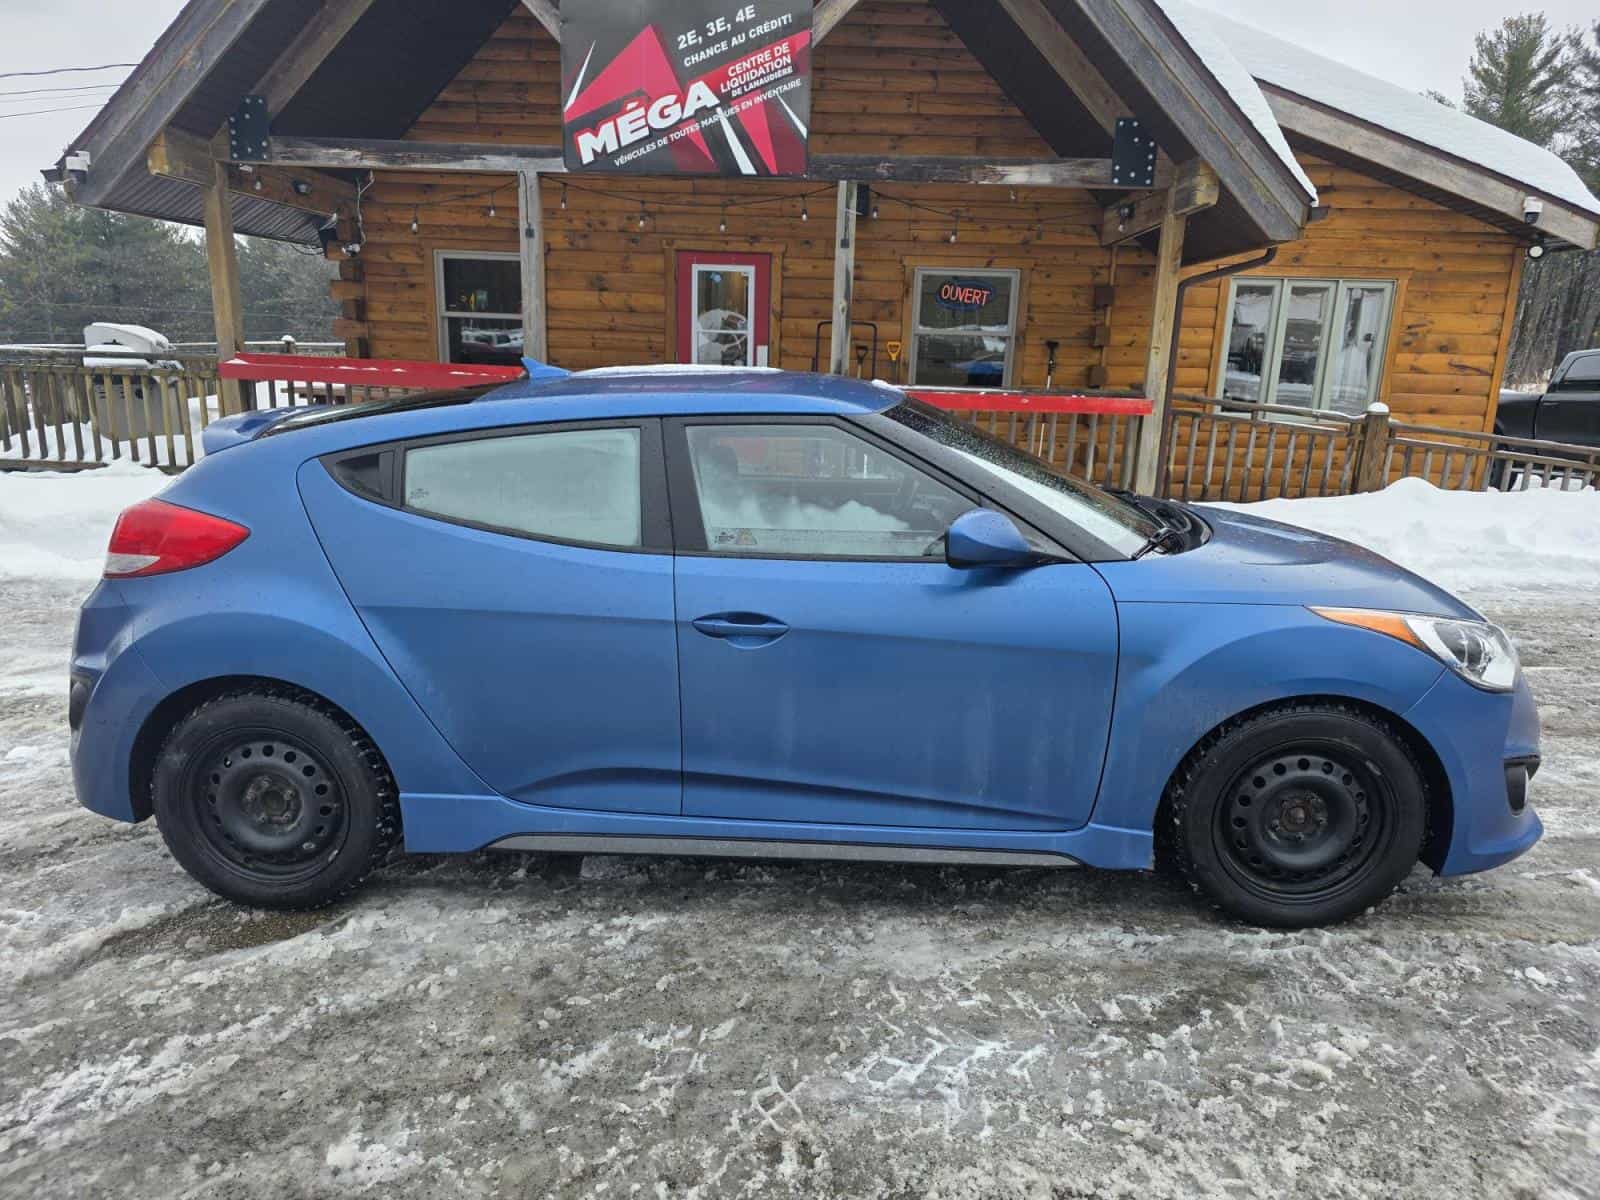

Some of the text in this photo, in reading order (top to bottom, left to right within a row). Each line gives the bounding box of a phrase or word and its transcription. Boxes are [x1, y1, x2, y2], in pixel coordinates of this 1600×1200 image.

[677, 4, 756, 50] 2E, 3E, 4E
[683, 40, 728, 67] CHANCE
[731, 33, 746, 48] AU
[728, 42, 790, 77] CENTRE DE
[720, 54, 792, 93] LIQUIDATION
[731, 86, 743, 97] DE
[577, 80, 720, 165] MÉGA
[657, 136, 669, 147] DE
[670, 122, 700, 142] TOUTES
[741, 99, 753, 111] EN
[754, 78, 801, 105] INVENTAIRE
[941, 284, 991, 306] OUVERT
